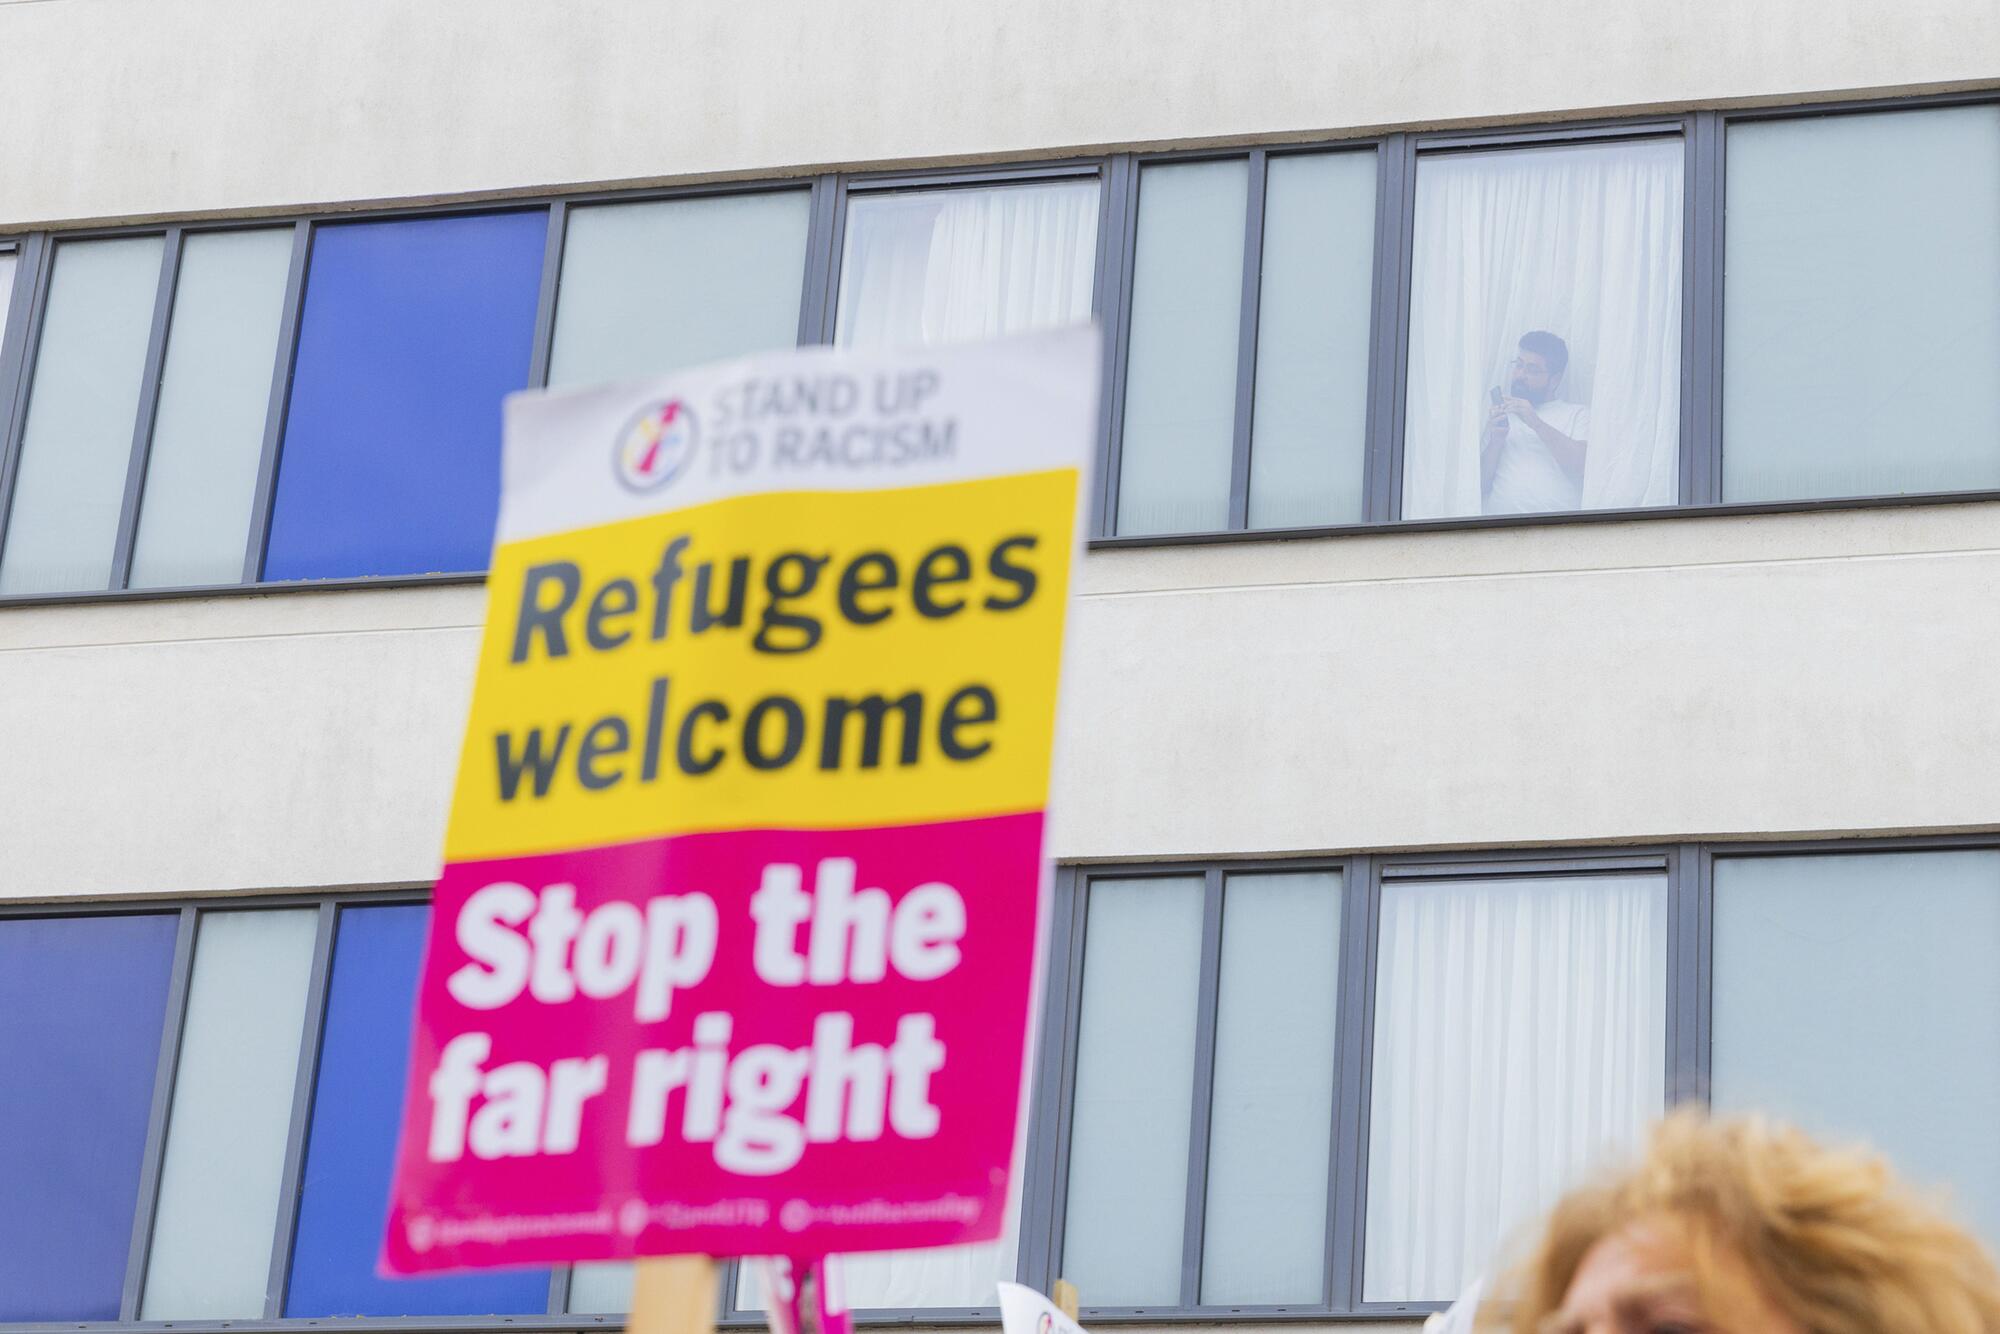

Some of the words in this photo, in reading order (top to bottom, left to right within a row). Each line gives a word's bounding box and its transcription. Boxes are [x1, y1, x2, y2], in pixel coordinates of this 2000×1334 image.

[710, 427, 759, 477] TO
[770, 417, 958, 471] RACISM
[711, 371, 860, 427] STAND
[872, 369, 942, 417] UP
[510, 533, 1042, 665] Refugees
[495, 676, 1000, 804] welcome
[446, 880, 720, 1024] Stop
[749, 856, 968, 988] the
[428, 1031, 609, 1164] far
[625, 1010, 947, 1177] right
